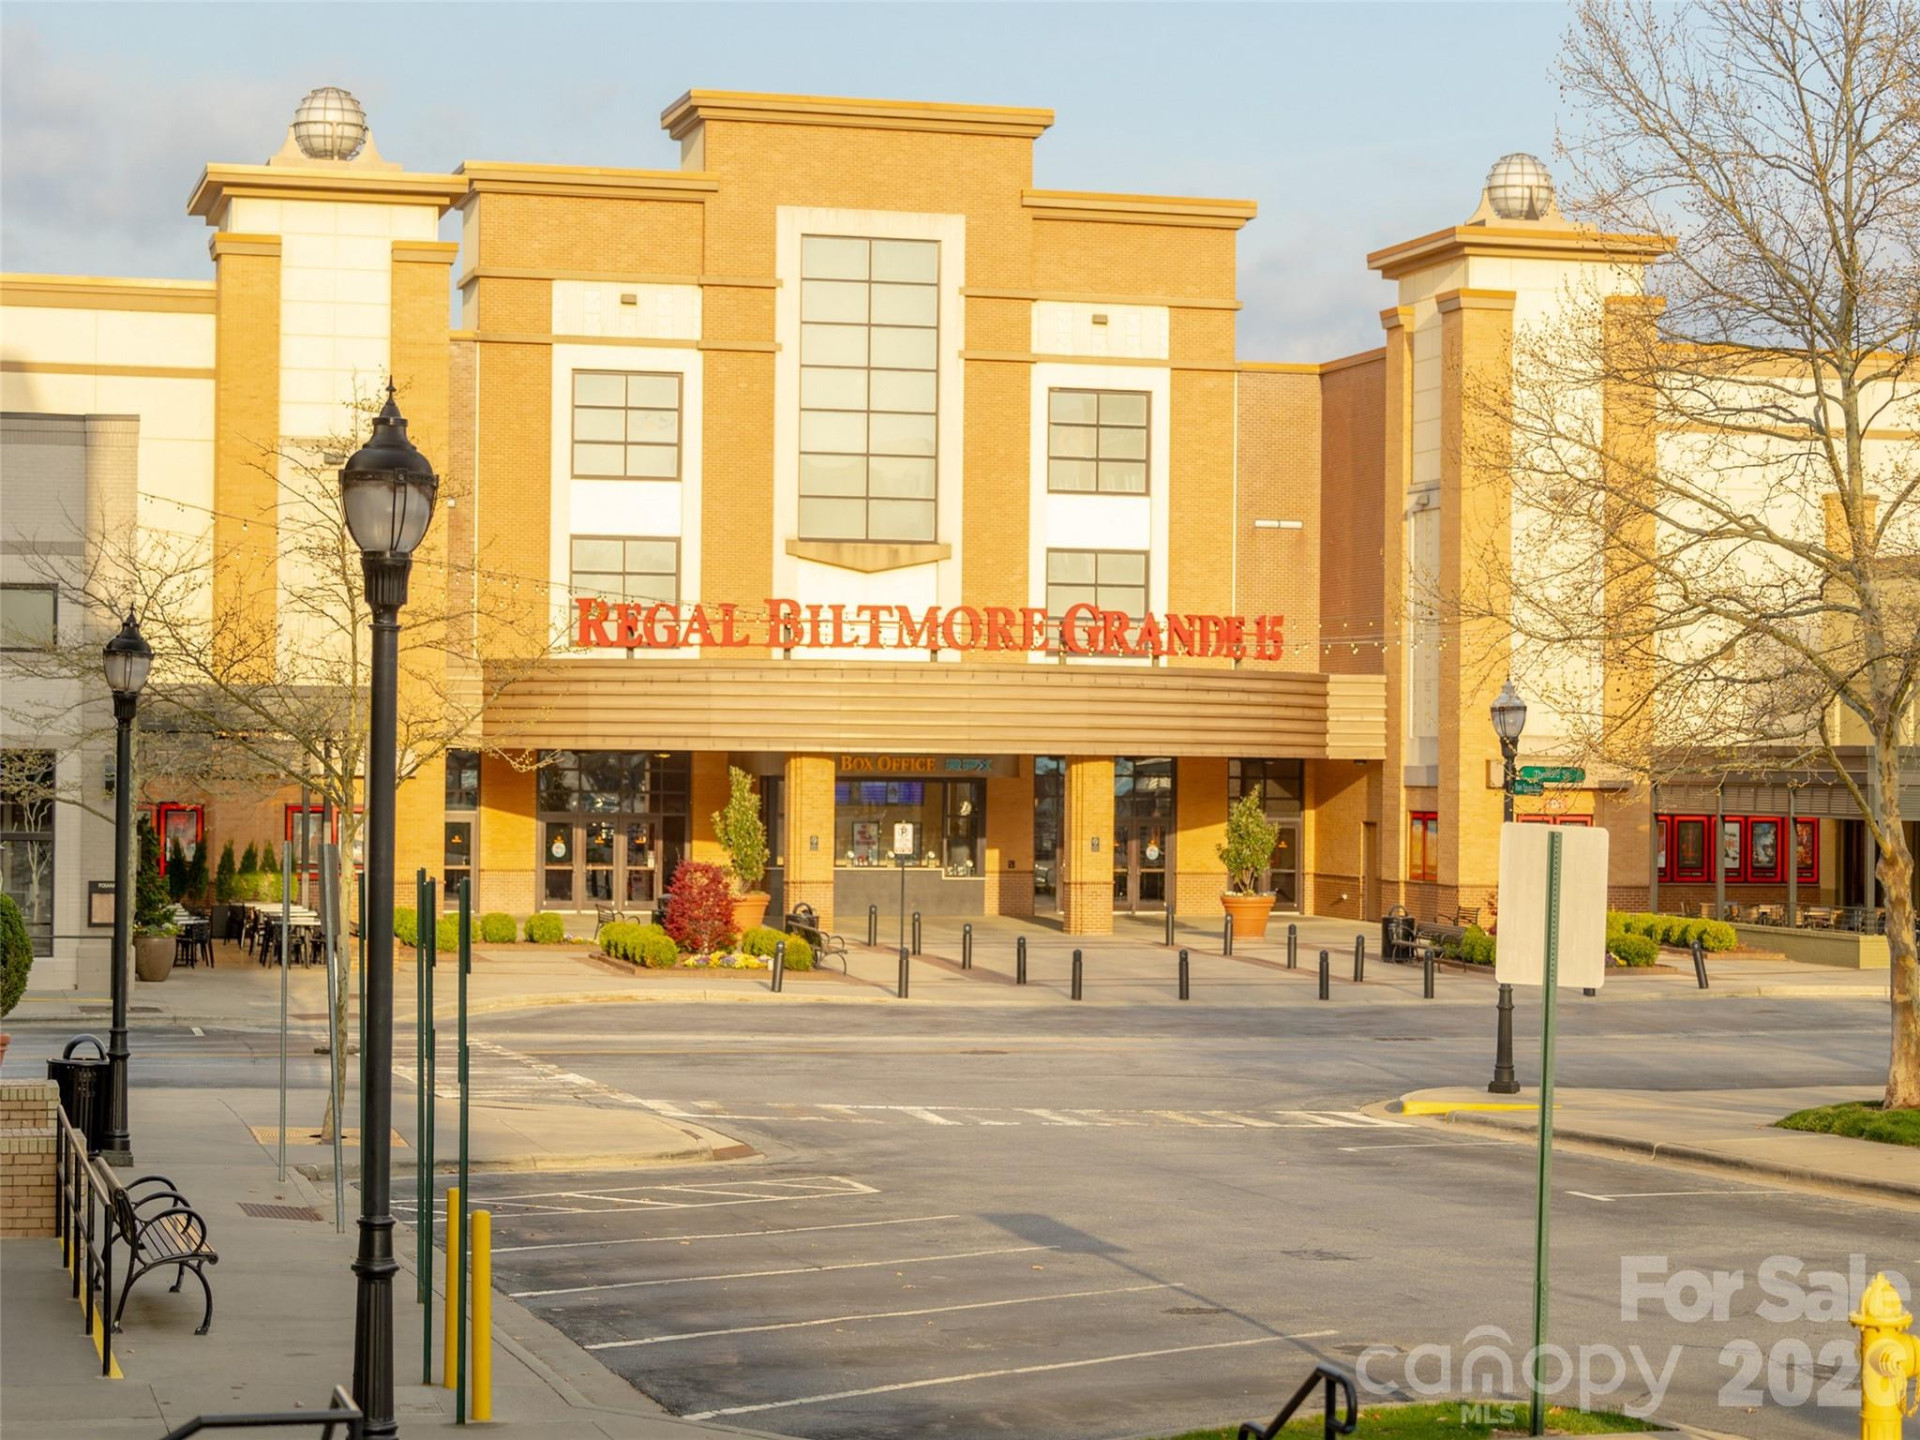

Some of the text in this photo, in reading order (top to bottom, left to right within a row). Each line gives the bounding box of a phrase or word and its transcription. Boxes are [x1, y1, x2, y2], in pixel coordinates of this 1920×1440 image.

[575, 598, 1284, 661] REGAL BILTMORE GRANDE 15
[841, 755, 935, 771] BOX OFFICE
